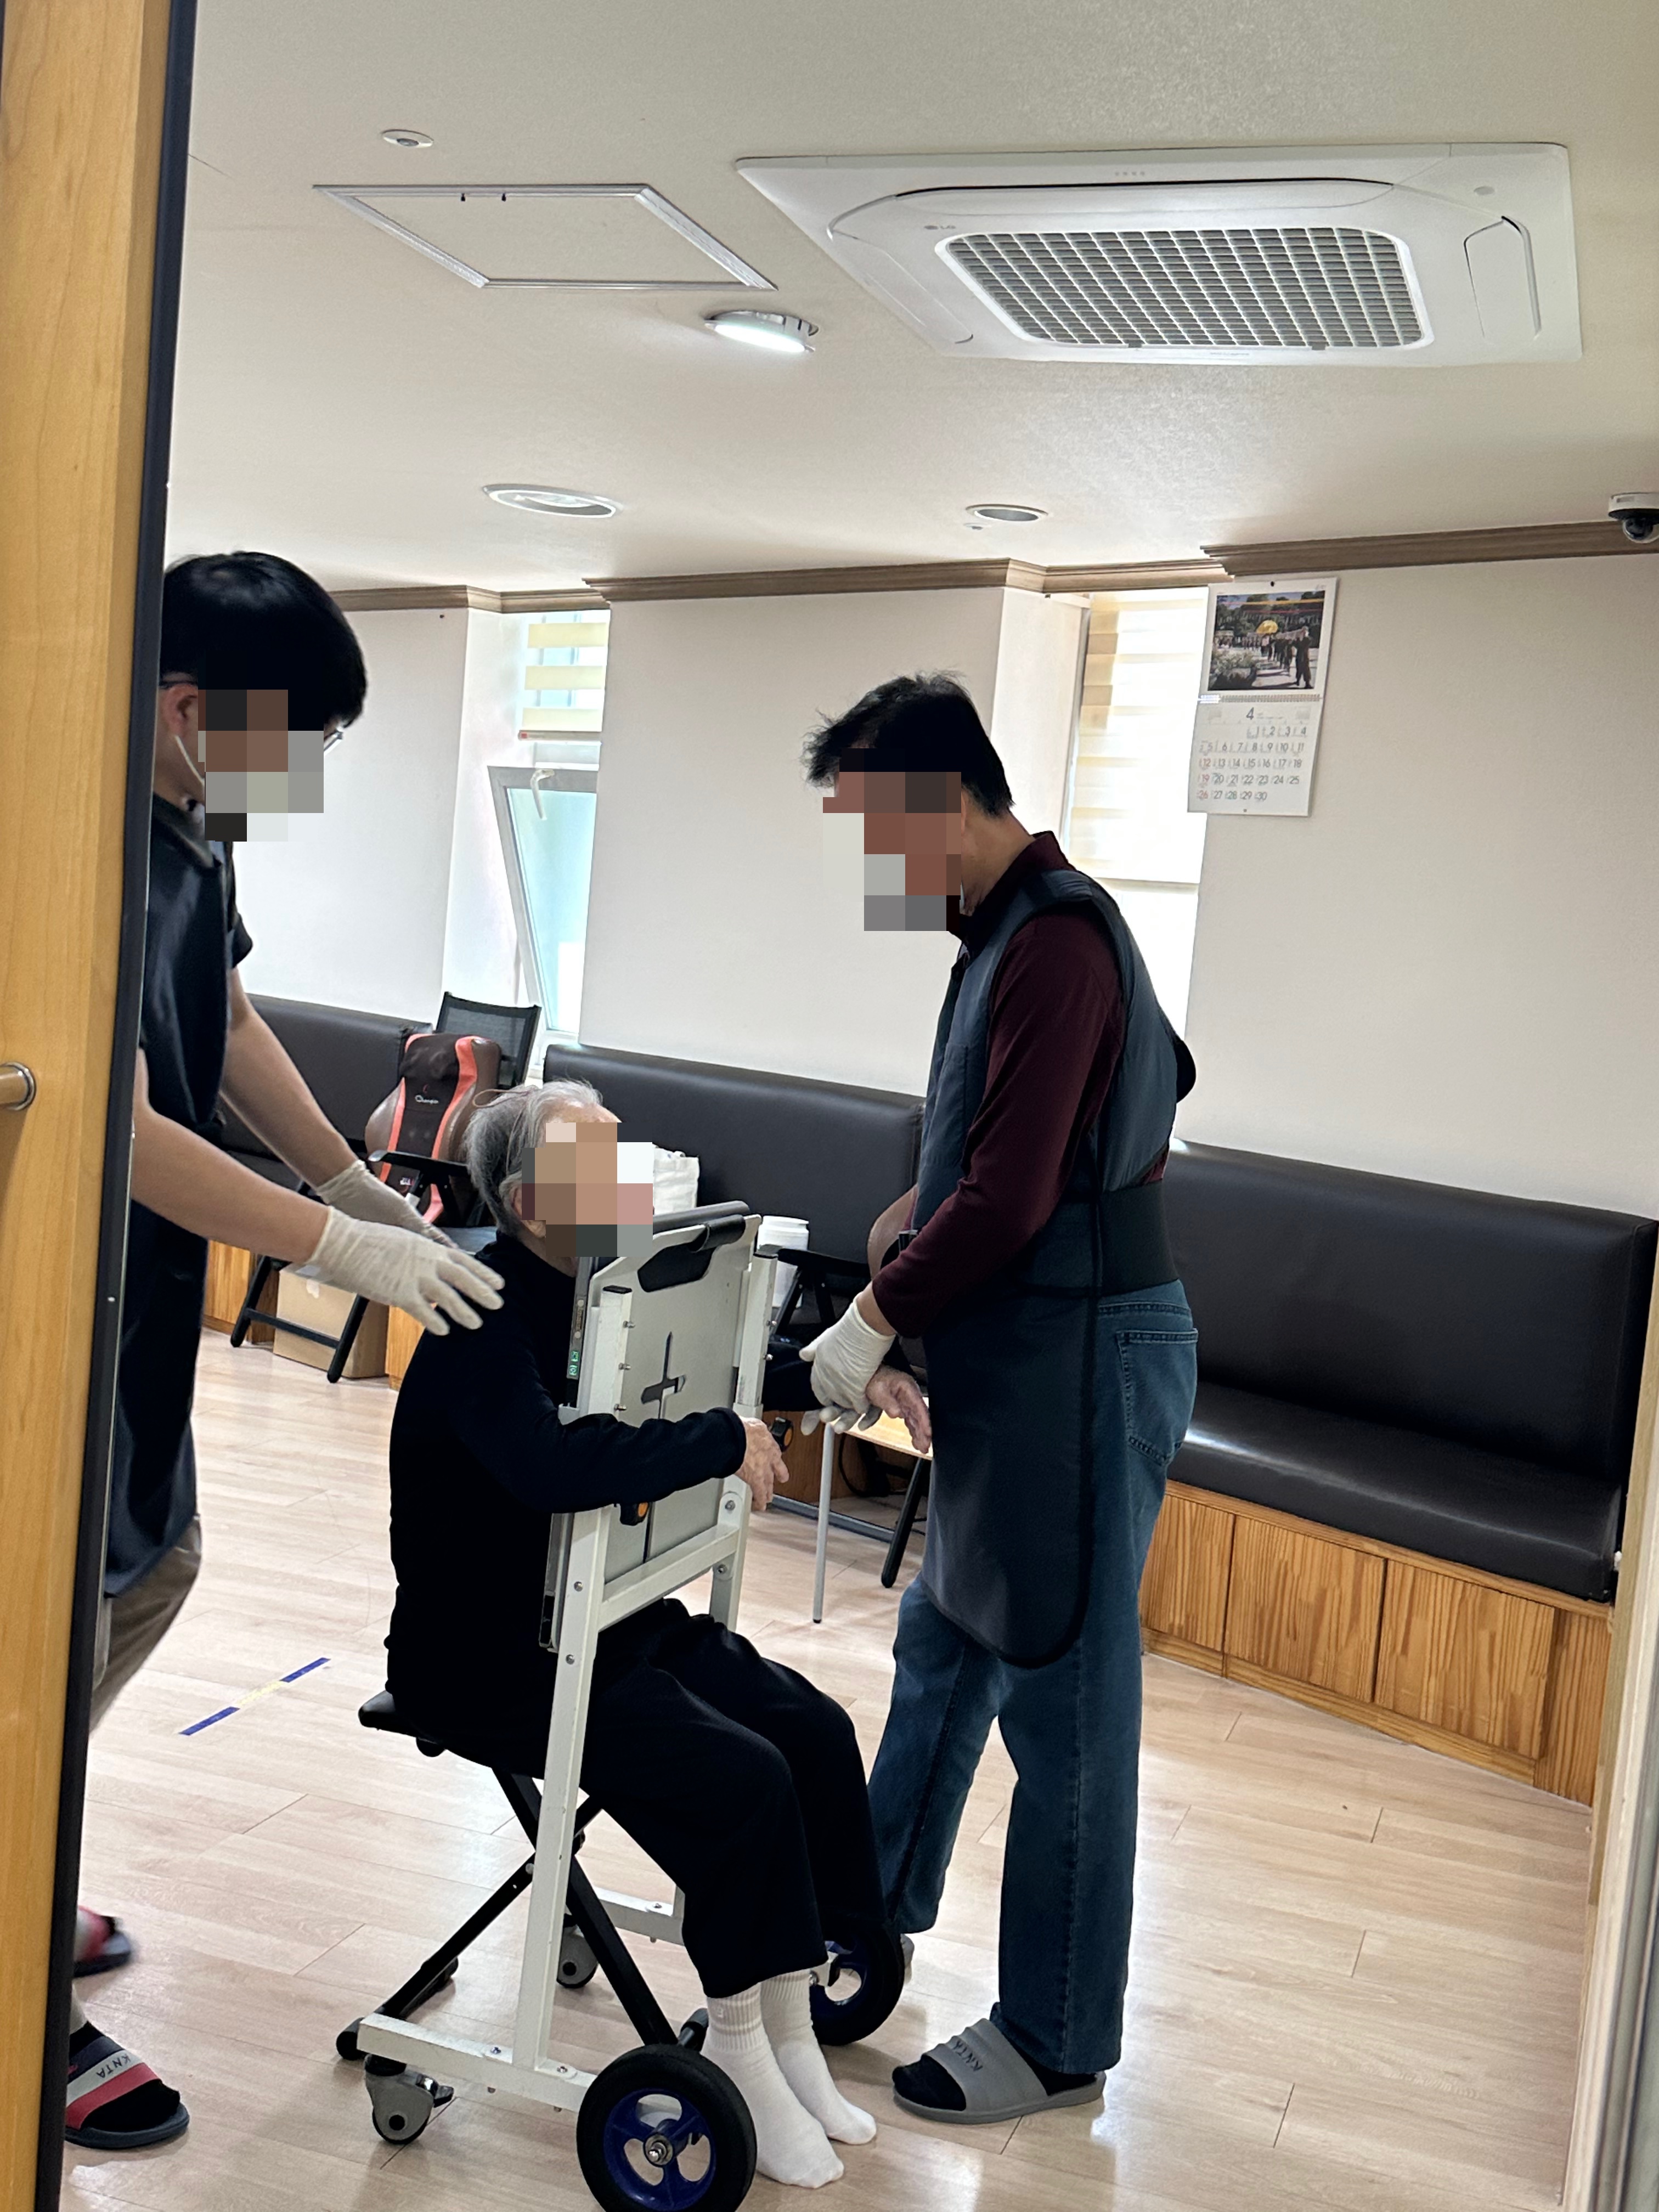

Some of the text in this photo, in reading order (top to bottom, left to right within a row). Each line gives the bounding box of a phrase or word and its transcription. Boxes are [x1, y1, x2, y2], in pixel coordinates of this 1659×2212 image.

[1246, 707, 1254, 720] 4
[1269, 726, 1276, 736] 2
[1285, 726, 1291, 737] 3
[1300, 726, 1307, 736] 4
[1222, 742, 1227, 751] 6
[1238, 742, 1244, 751] 7
[1252, 742, 1257, 752] 8
[1267, 742, 1273, 751] 9
[1280, 742, 1289, 752] 10
[1297, 742, 1305, 752] 11
[1203, 758, 1302, 768] 12 13 14 15 16 17 18
[1202, 774, 1299, 785] 19 20 21 22 23 24 25
[1199, 790, 1267, 801] 26 27 28 29 30
[96, 2054, 131, 2078] KNTA
